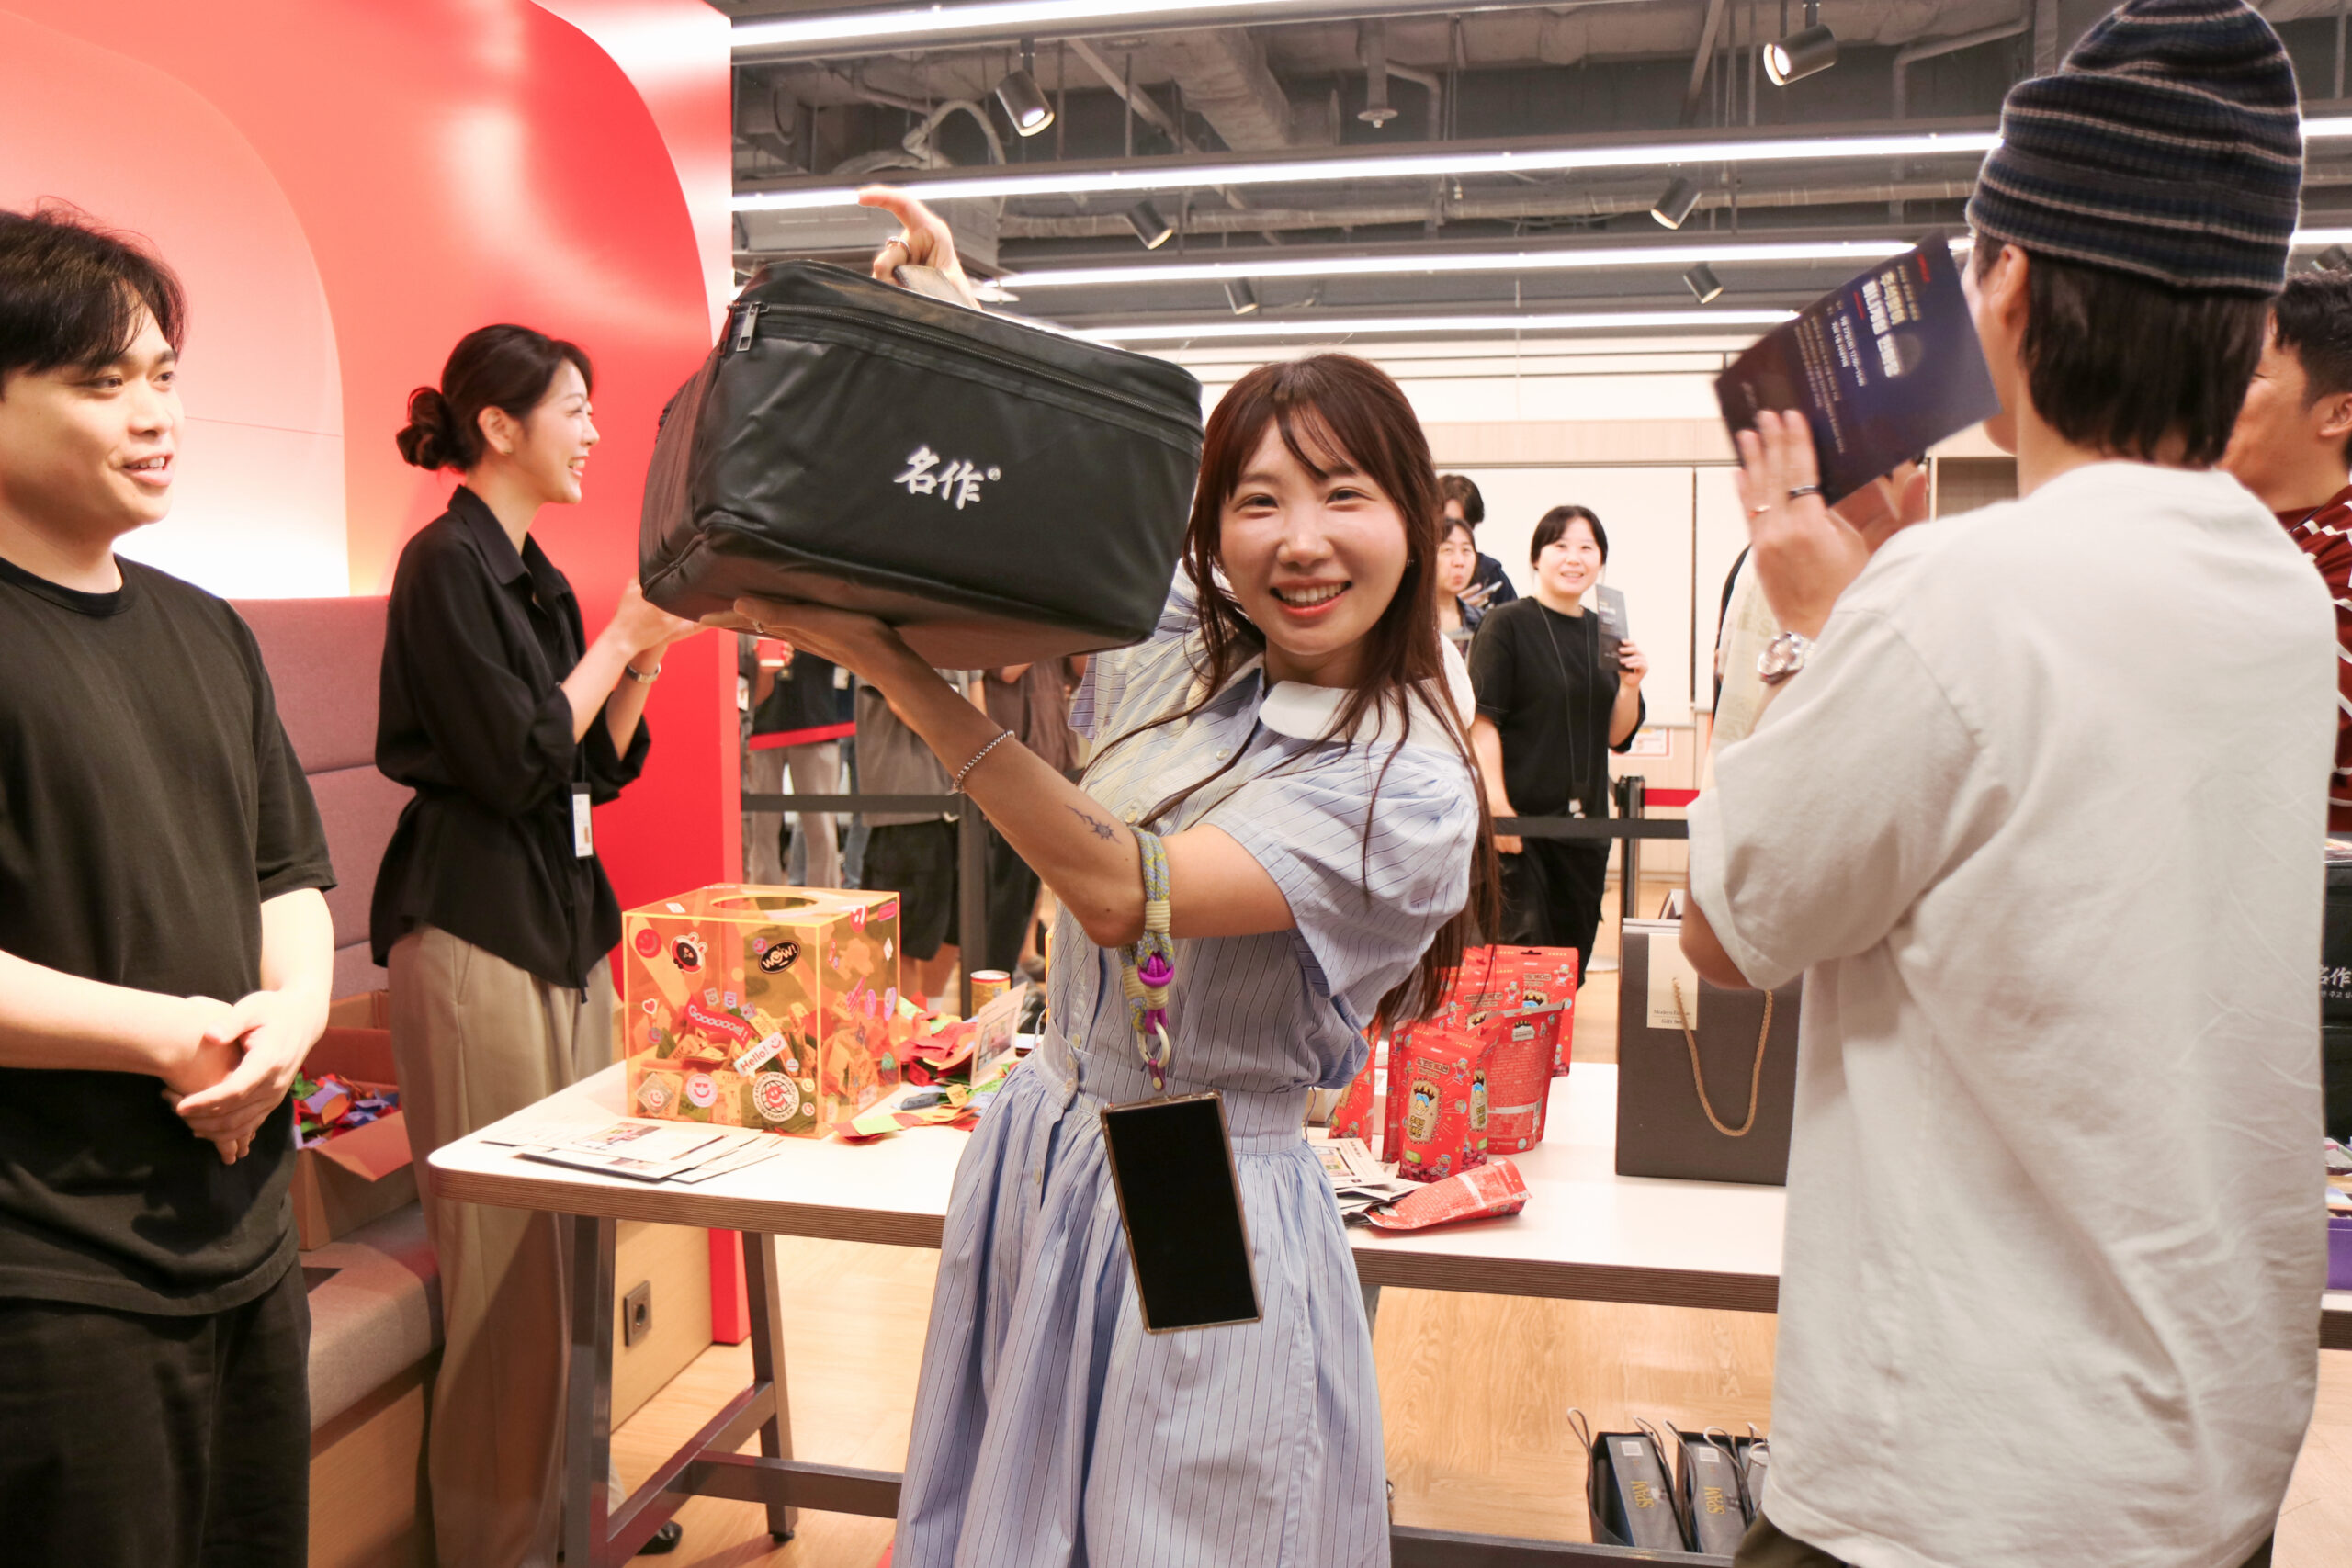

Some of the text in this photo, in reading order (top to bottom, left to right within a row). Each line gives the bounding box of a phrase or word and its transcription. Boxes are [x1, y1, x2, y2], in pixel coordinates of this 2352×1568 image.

[893, 445, 986, 511] 名作
[740, 1045, 770, 1072] Hello!
[1631, 1480, 1655, 1508] SPAM
[1704, 1485, 1725, 1514] SPAM
